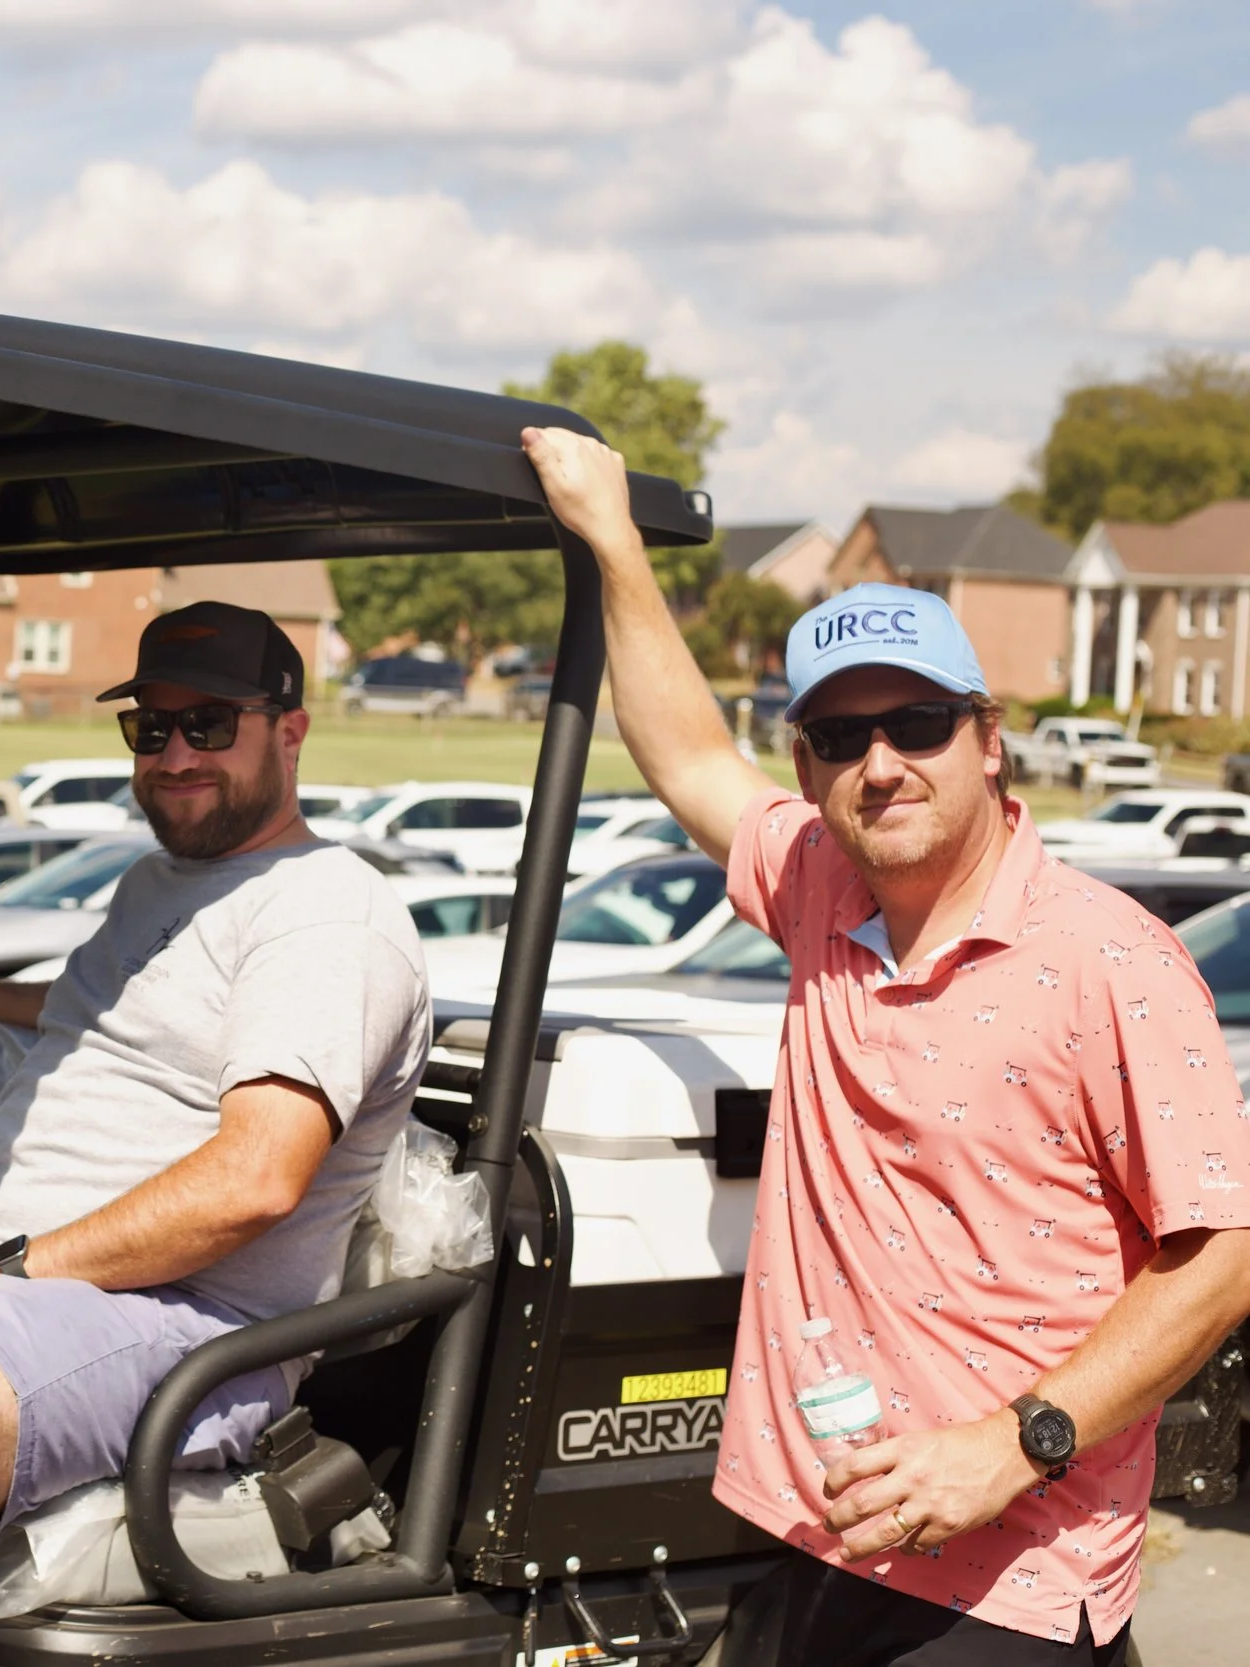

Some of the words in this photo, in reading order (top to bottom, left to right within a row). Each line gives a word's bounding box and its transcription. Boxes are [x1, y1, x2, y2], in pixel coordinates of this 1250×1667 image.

[815, 609, 918, 650] URCC
[626, 1371, 719, 1402] 12393481
[557, 1397, 727, 1462] CARRYA
